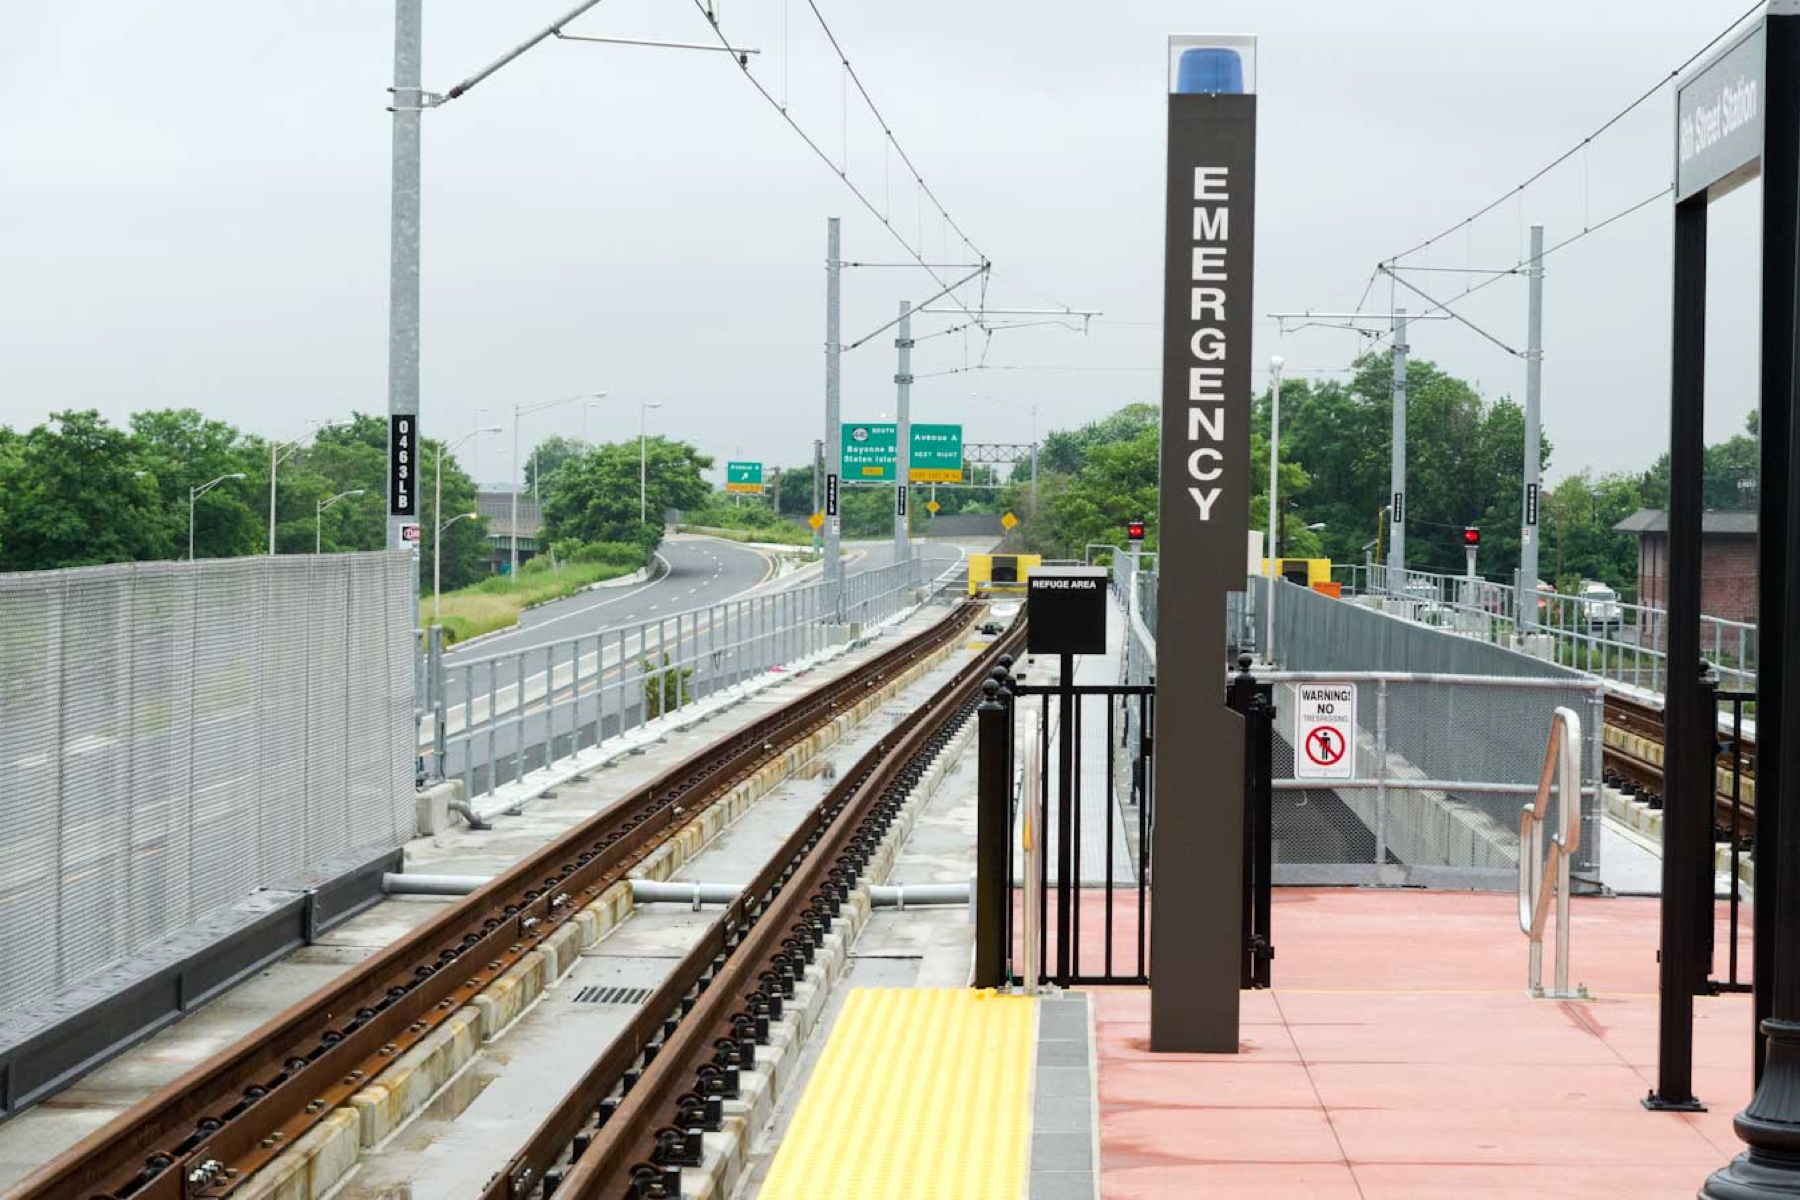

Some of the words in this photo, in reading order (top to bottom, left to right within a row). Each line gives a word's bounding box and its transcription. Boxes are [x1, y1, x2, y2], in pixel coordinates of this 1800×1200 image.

[1696, 95, 1720, 154] Street
[1722, 75, 1757, 136] Station
[1186, 165, 1230, 522] EMERGENCY
[847, 446, 885, 455] Bayonne
[398, 419, 409, 509] 0463LB
[844, 455, 873, 463] Staten
[1032, 580, 1069, 589] REFUGE
[1070, 580, 1097, 589] AREA
[1302, 690, 1351, 702] WARNING!
[1317, 703, 1335, 714] NO
